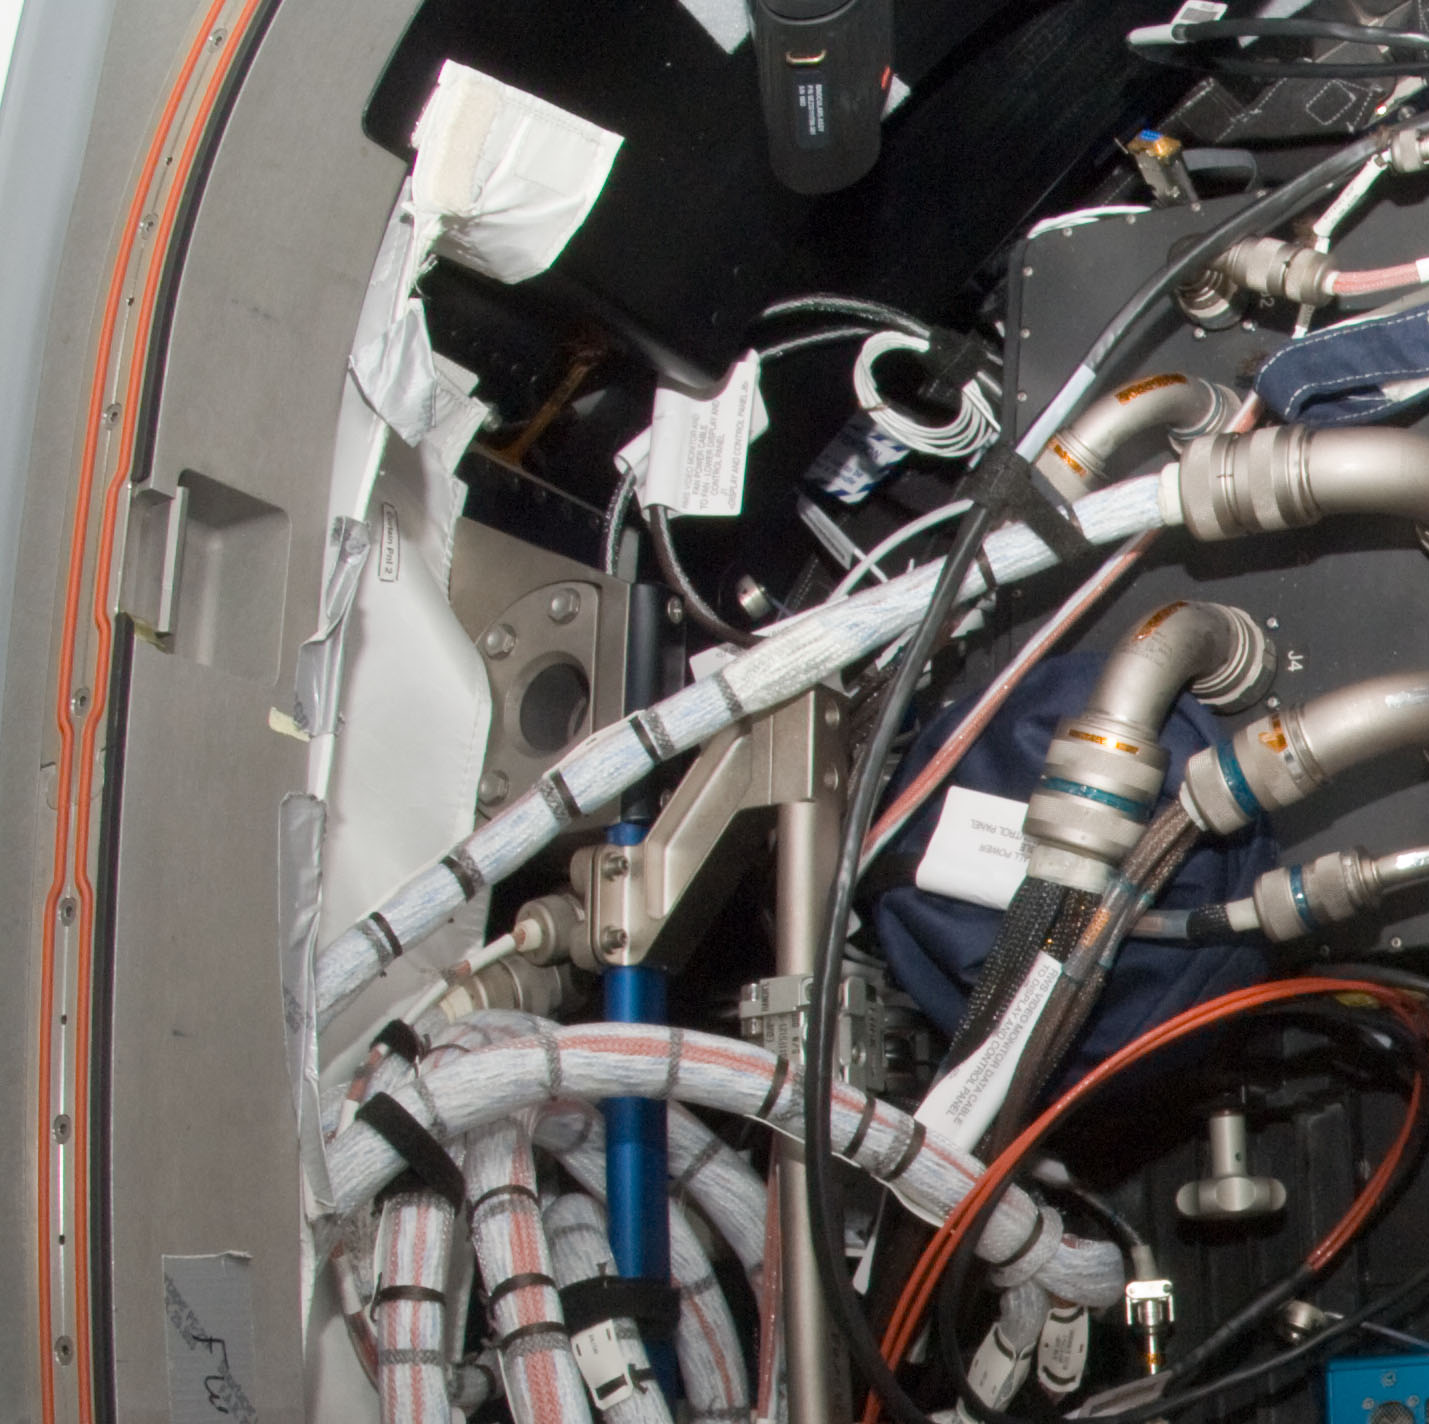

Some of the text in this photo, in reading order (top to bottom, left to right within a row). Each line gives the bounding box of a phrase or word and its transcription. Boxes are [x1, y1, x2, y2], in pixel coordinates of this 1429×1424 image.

[385, 547, 394, 564] Pnl
[1287, 650, 1303, 672] J4
[967, 818, 997, 834] PANEL
[1009, 976, 1040, 1020] DISPLAY
[1017, 990, 1043, 1025] VIDEO
[965, 1037, 1000, 1088] CONTROL
[988, 1021, 1023, 1070] MONITOR
[972, 1067, 994, 1095] DATA
[944, 1084, 970, 1119] PANEL
[951, 1091, 978, 1127] CABLE
